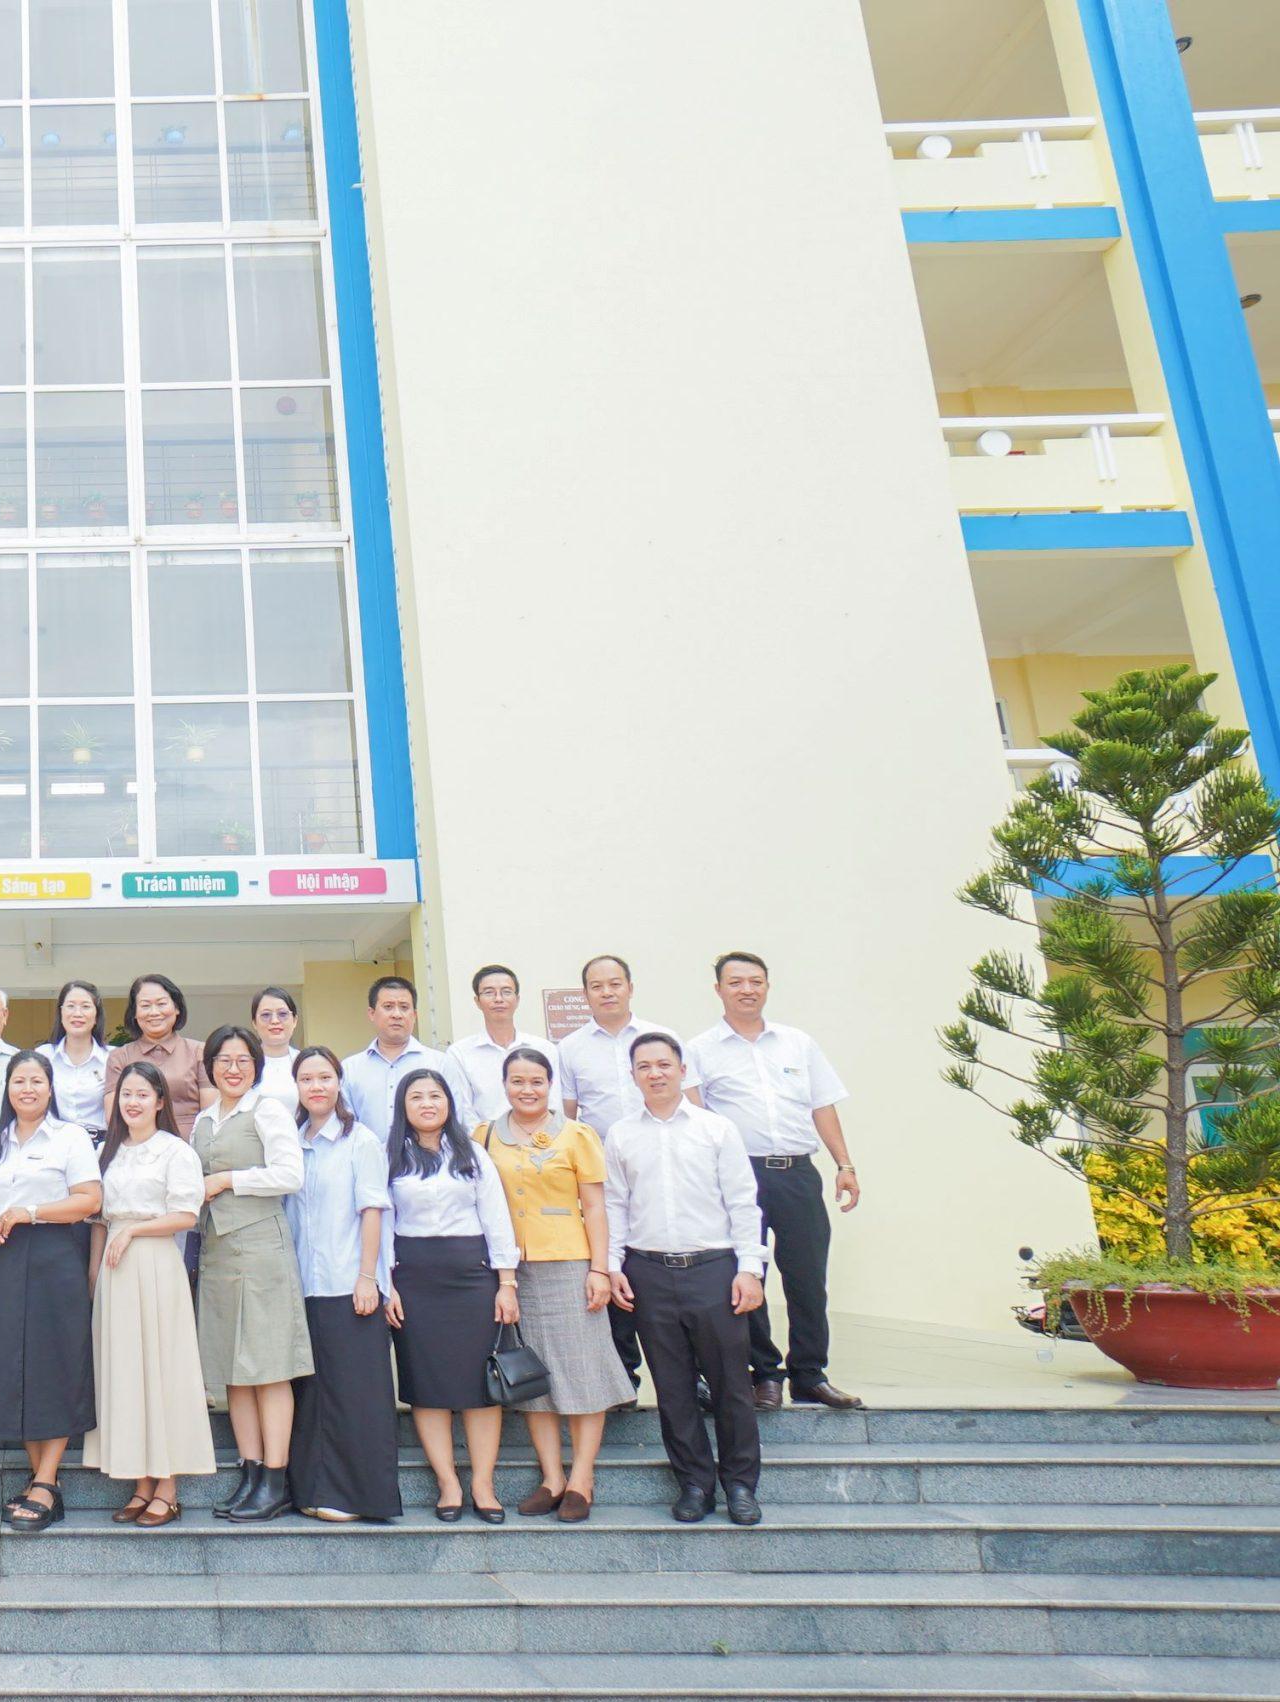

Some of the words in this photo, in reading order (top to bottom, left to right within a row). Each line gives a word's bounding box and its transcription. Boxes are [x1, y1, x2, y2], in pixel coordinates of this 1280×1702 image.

[1, 877, 38, 896] Sáng
[41, 877, 66, 896] tạo
[135, 875, 177, 892] Trách
[181, 875, 226, 894] nhiệm
[296, 873, 320, 892] Hội
[324, 873, 359, 892] nhập
